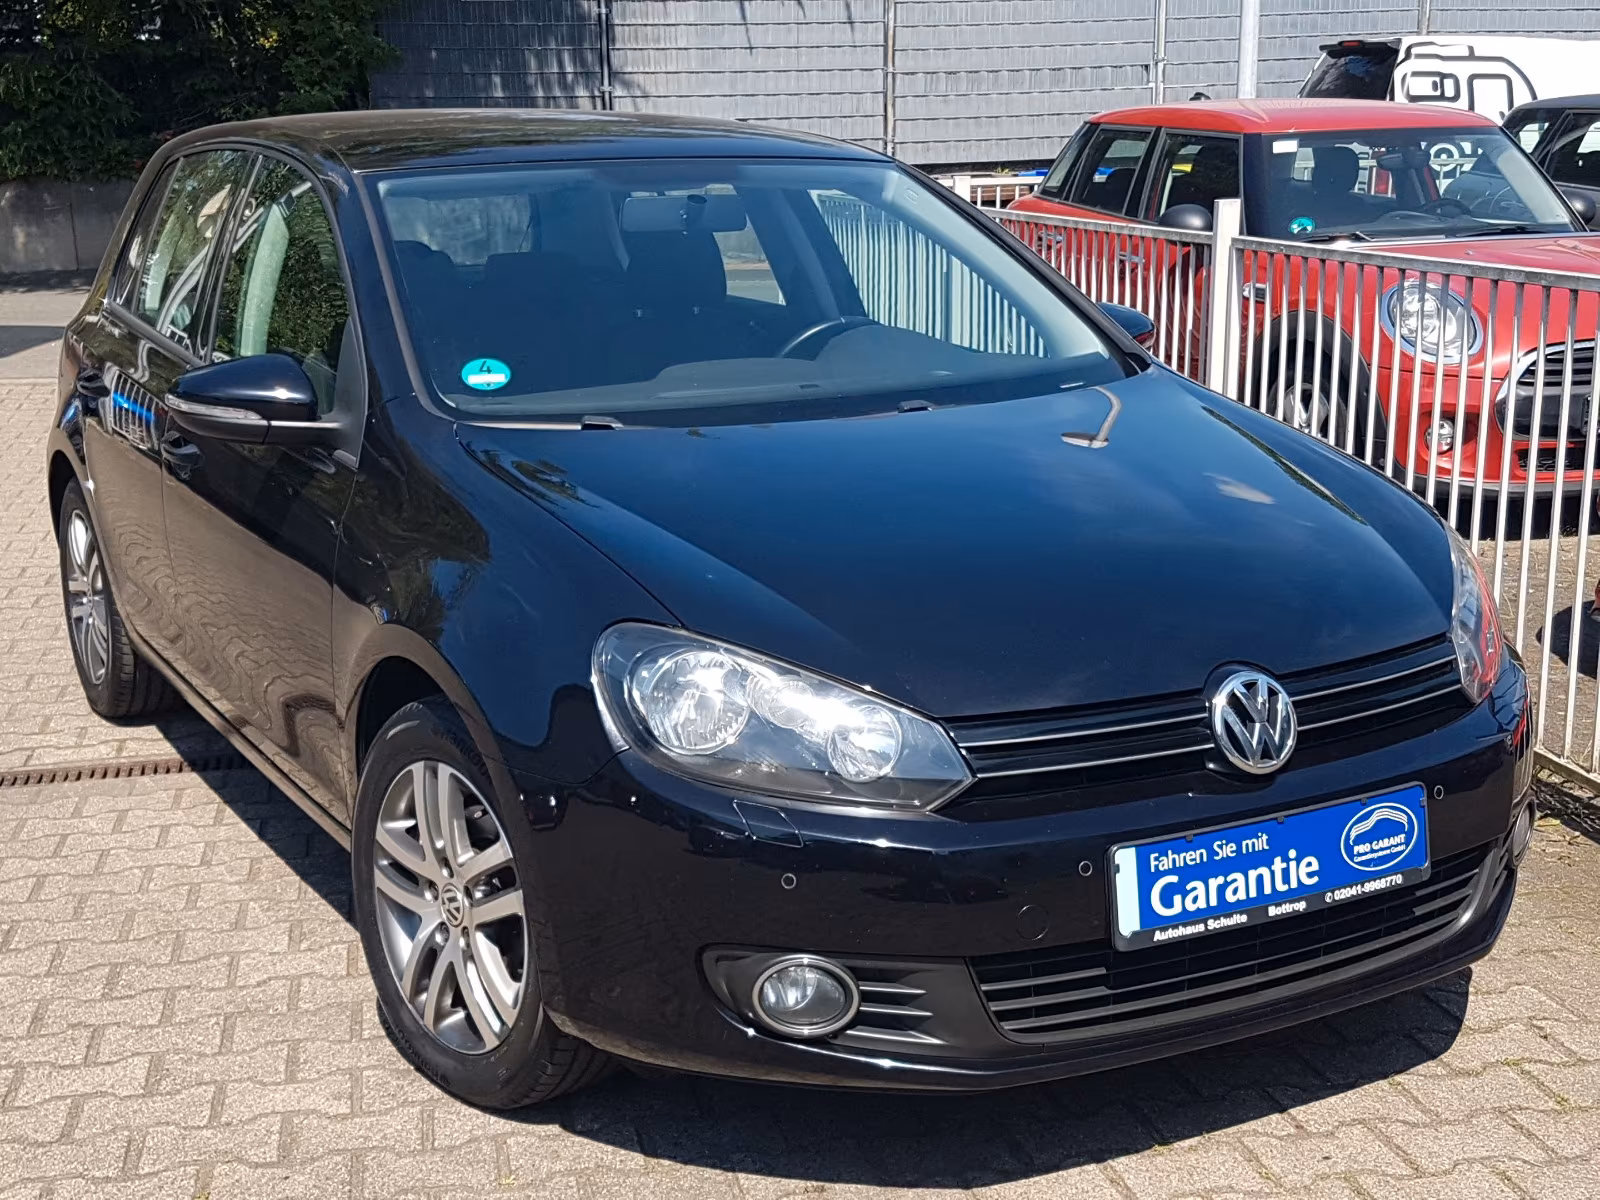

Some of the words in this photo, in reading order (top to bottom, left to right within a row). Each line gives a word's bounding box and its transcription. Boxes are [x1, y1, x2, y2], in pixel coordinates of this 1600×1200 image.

[479, 360, 493, 374] 4
[1150, 850, 1207, 872] Fahren
[1213, 839, 1237, 860] Sie
[1242, 832, 1270, 854] mit
[1353, 843, 1371, 855] PRO
[1372, 834, 1406, 850] GARANT
[1150, 849, 1320, 917] Garantie
[1153, 922, 1205, 941] Autohaus
[1206, 913, 1248, 930] Schulte
[1268, 900, 1307, 917] Bottrop
[1333, 874, 1403, 900] 02041-9968770
